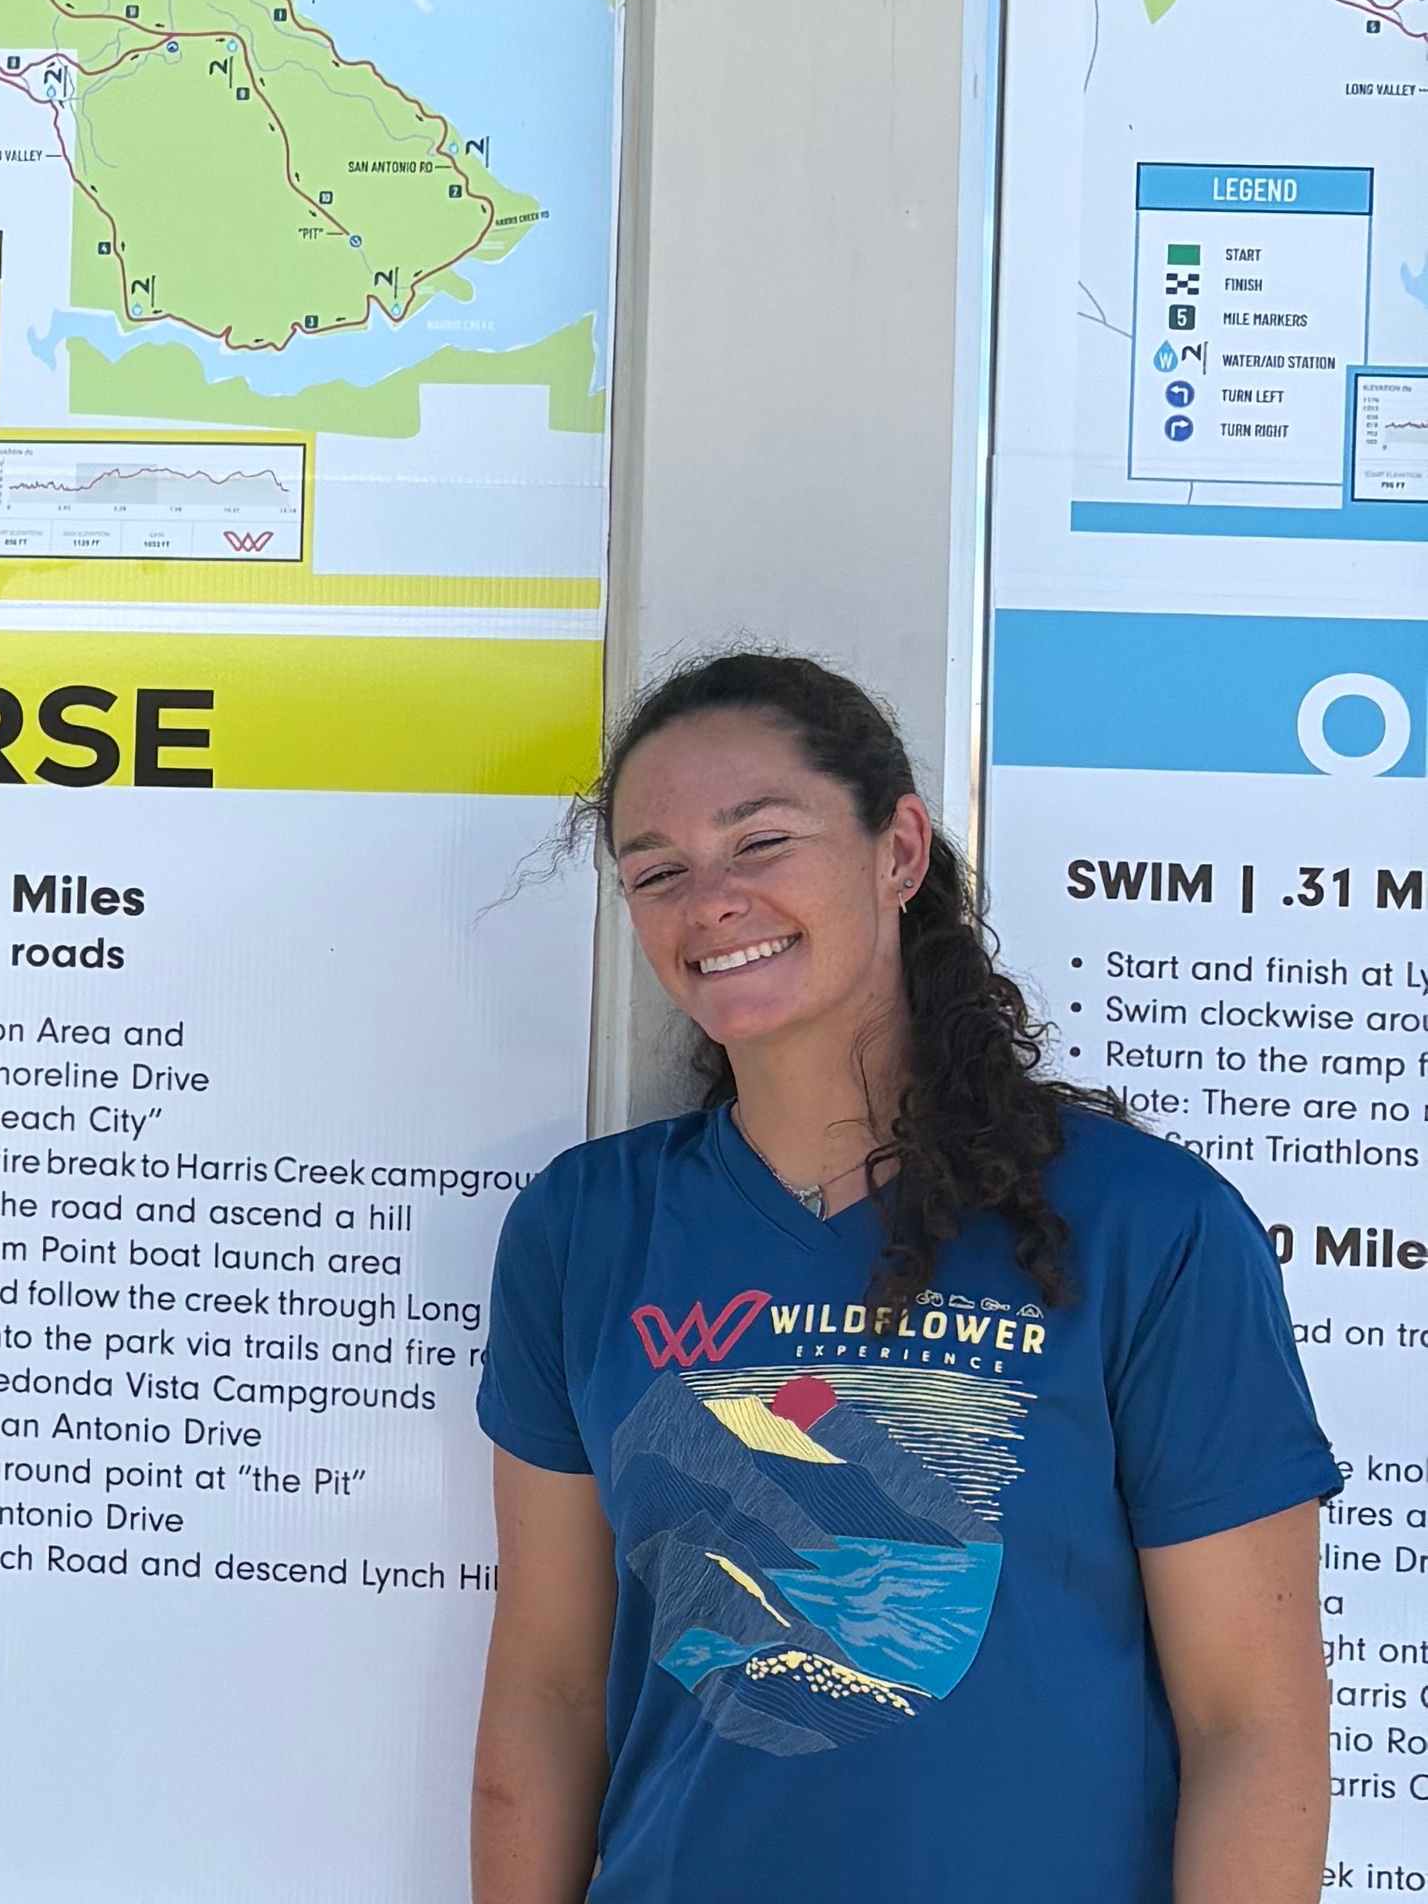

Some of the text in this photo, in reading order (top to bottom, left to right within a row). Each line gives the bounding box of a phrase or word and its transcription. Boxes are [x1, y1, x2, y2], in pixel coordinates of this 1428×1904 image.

[1214, 177, 1297, 202] LEGEND
[1226, 248, 1261, 261] START
[13, 874, 144, 916] Miles
[1067, 860, 1349, 907] SWIM .31
[12, 938, 124, 969] roads
[1107, 951, 1392, 986] Start and finish at
[37, 1017, 110, 1044] Area
[125, 1021, 183, 1046] and
[1266, 1136, 1418, 1166] Triathlons
[796, 1344, 1004, 1373] EXPERIENCE
[107, 1504, 183, 1532] Drive
